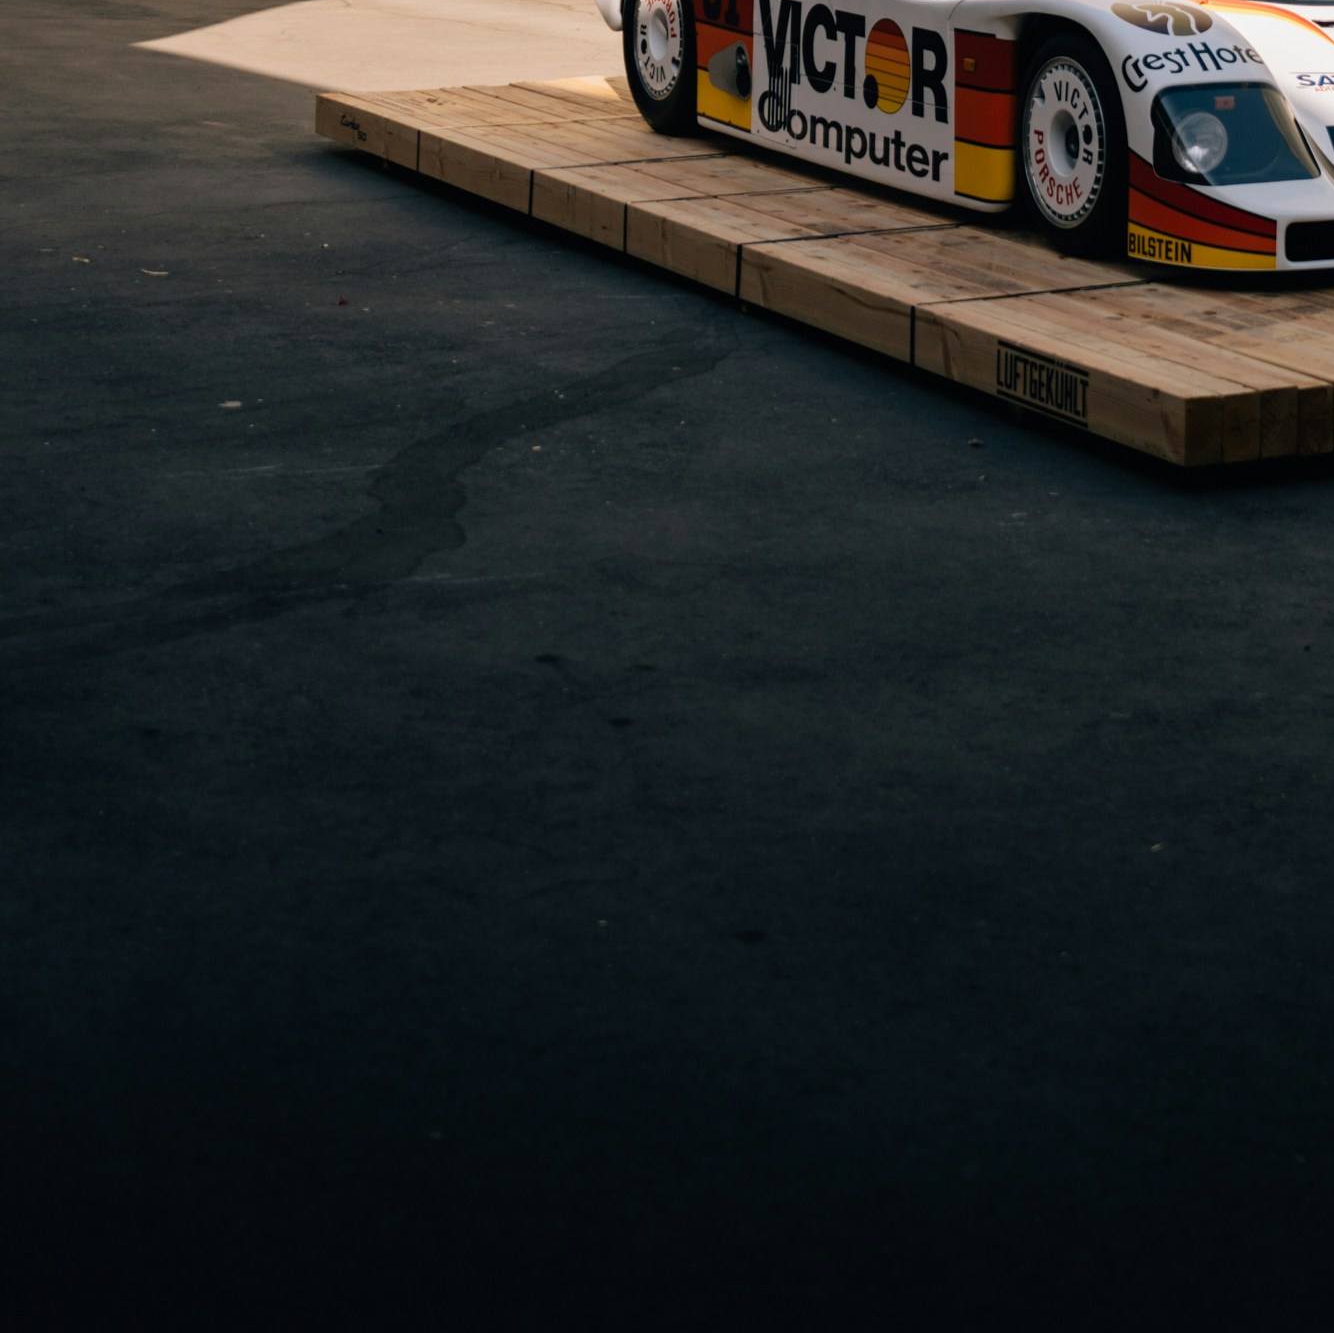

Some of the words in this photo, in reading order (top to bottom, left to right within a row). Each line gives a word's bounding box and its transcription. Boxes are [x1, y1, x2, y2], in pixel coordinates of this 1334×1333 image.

[640, 23, 667, 83] VICTOR
[1121, 47, 1190, 93] Crest
[1187, 41, 1264, 72] Hote
[758, 90, 949, 182] Computer
[1053, 80, 1093, 165] VICTOR
[1033, 129, 1083, 205] PORSCHE
[1128, 232, 1192, 263] BILSTEIN
[996, 348, 1089, 418] LUFTGEKÜHLT
